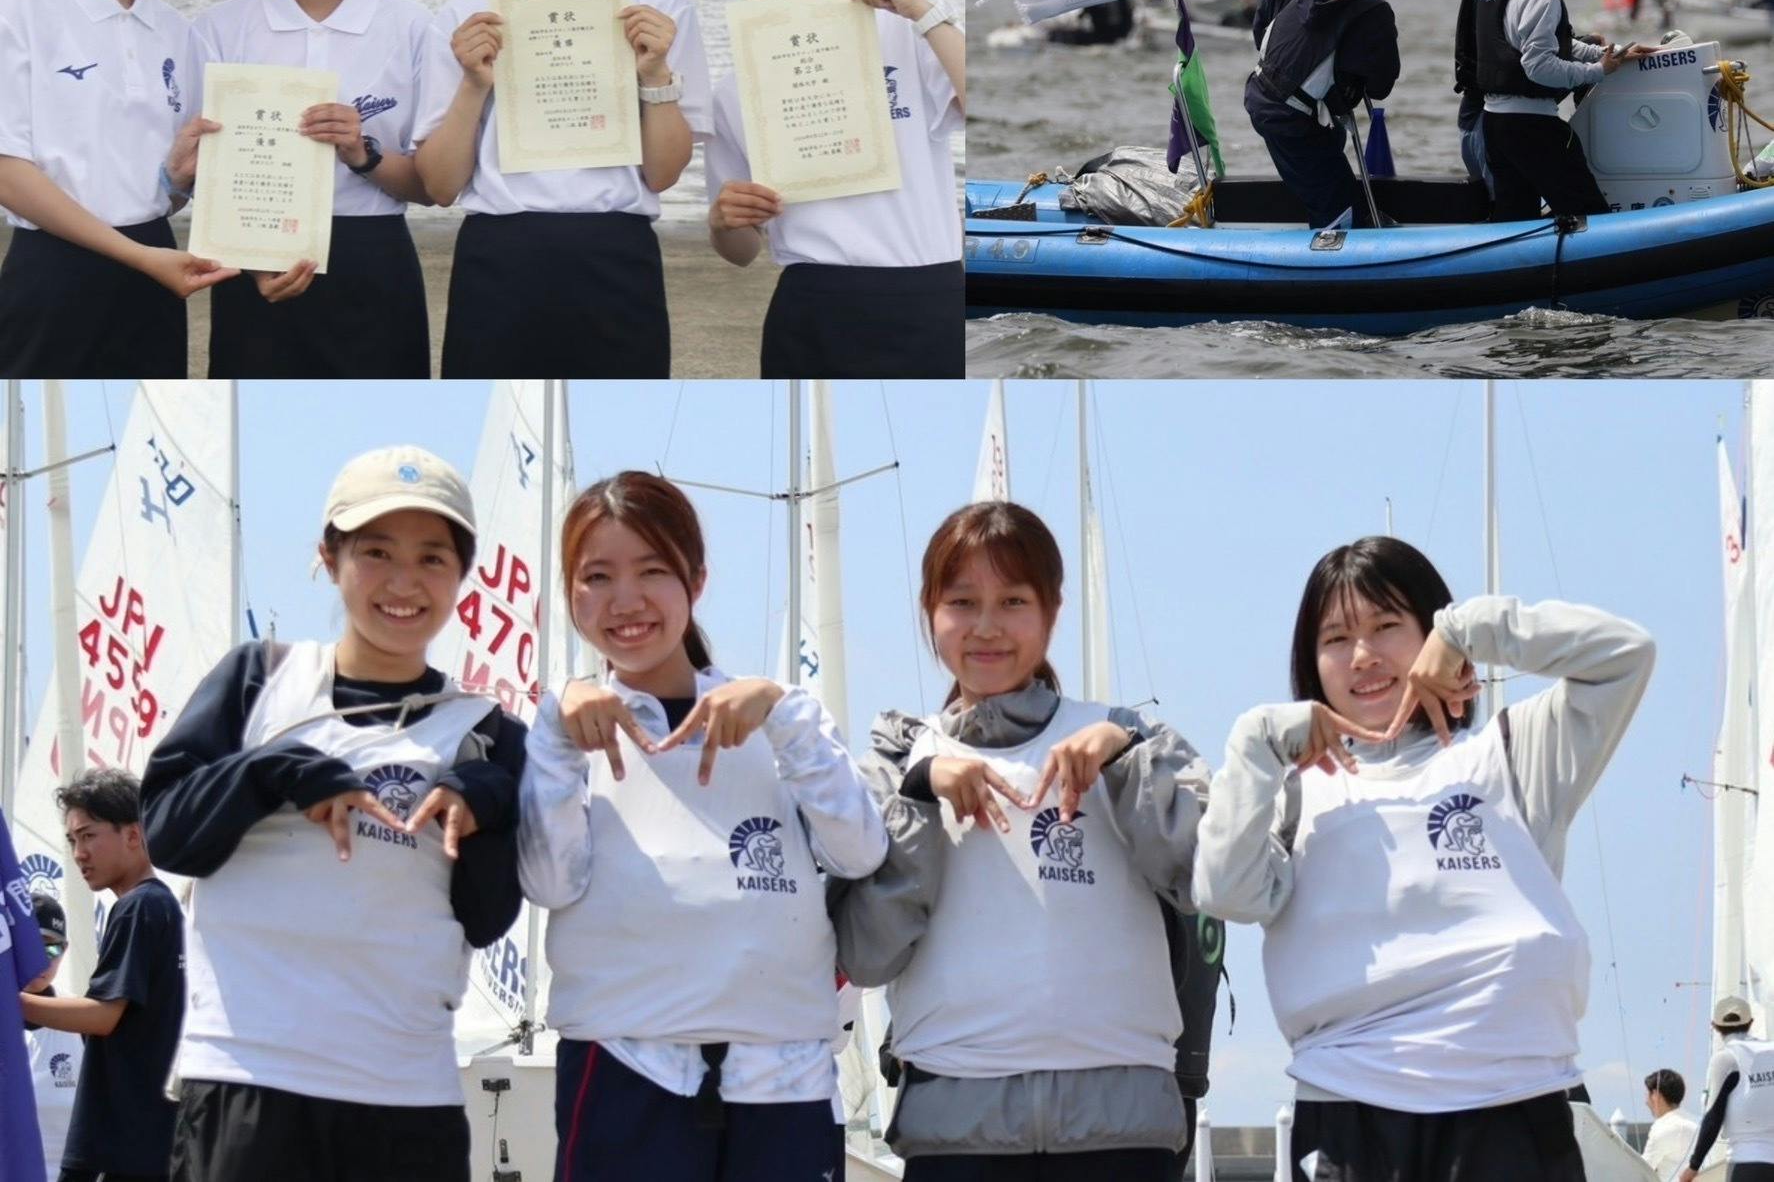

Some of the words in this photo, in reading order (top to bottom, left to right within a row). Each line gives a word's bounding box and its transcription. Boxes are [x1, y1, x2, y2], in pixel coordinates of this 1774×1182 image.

[1638, 49, 1698, 72] KAISERS
[356, 821, 418, 850] KAISERS
[1436, 856, 1502, 871] KAISERS
[1038, 866, 1095, 885] KAISERS
[737, 876, 797, 894] KAISERS
[1748, 1070, 1774, 1084] KAIS
